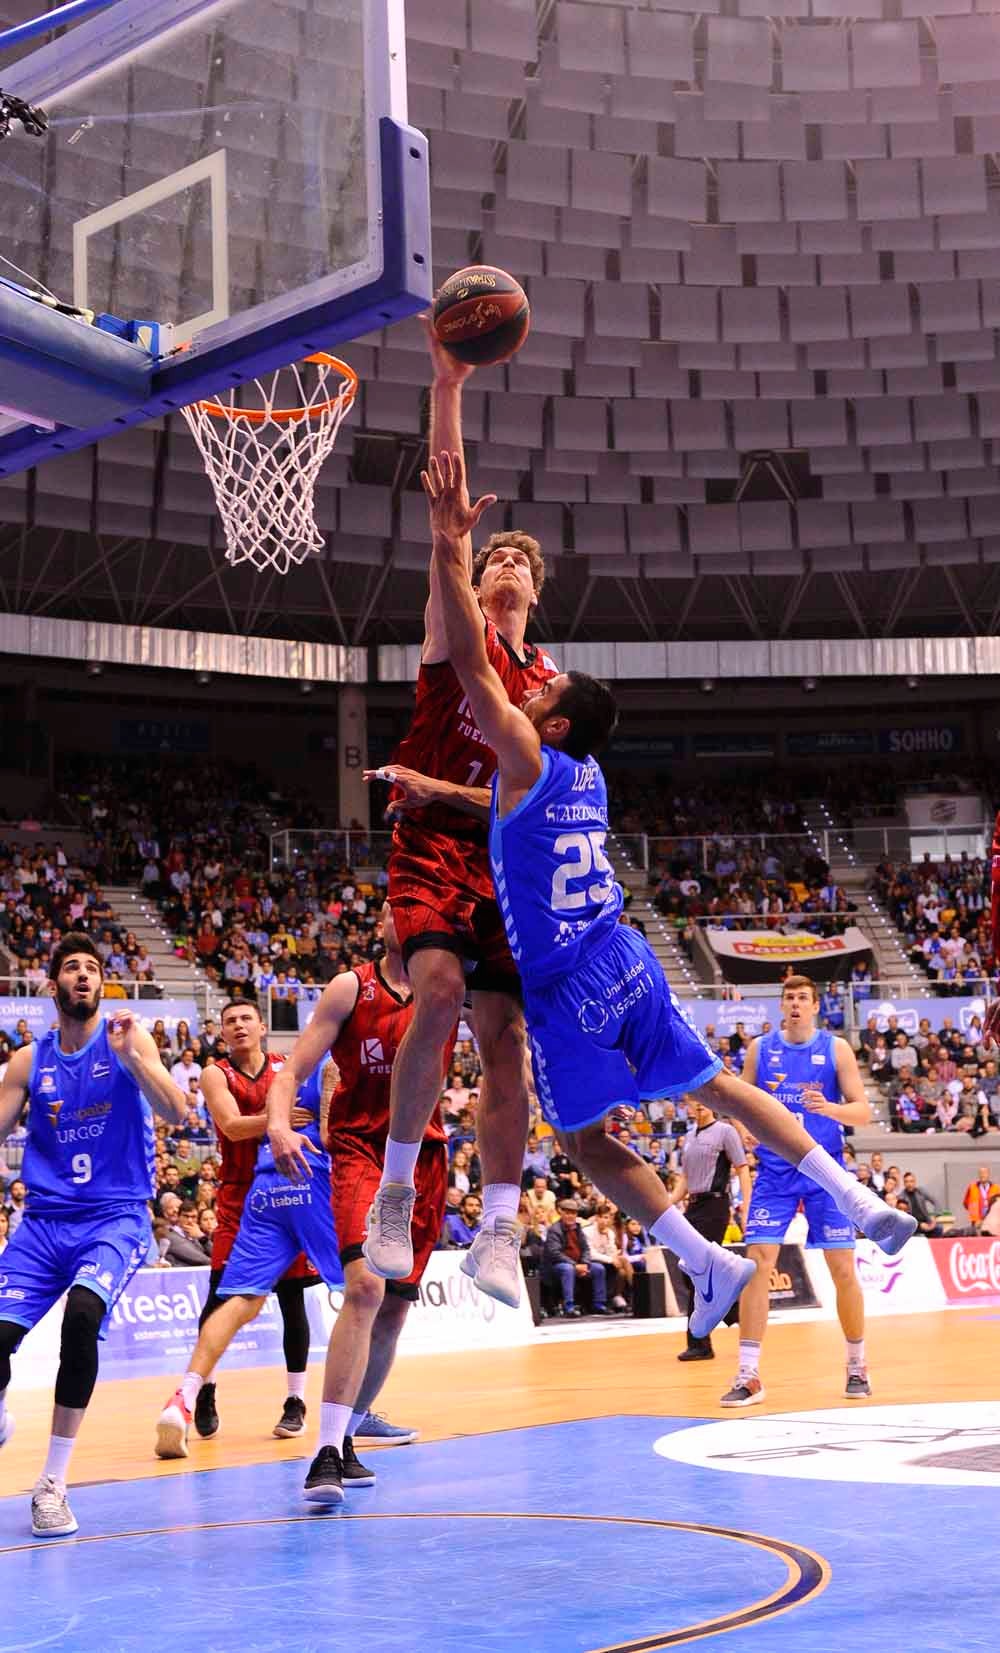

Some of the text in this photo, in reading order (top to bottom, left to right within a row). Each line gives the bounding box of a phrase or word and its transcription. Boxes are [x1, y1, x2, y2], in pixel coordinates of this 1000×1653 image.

[457, 721, 487, 745] FUE
[345, 745, 361, 768] B
[551, 831, 615, 911] 25
[738, 940, 837, 954] Pascual
[0, 1003, 44, 1016] oletas
[56, 1121, 107, 1144] URGOS
[72, 1153, 92, 1184] 9
[271, 1194, 304, 1208] Isabel
